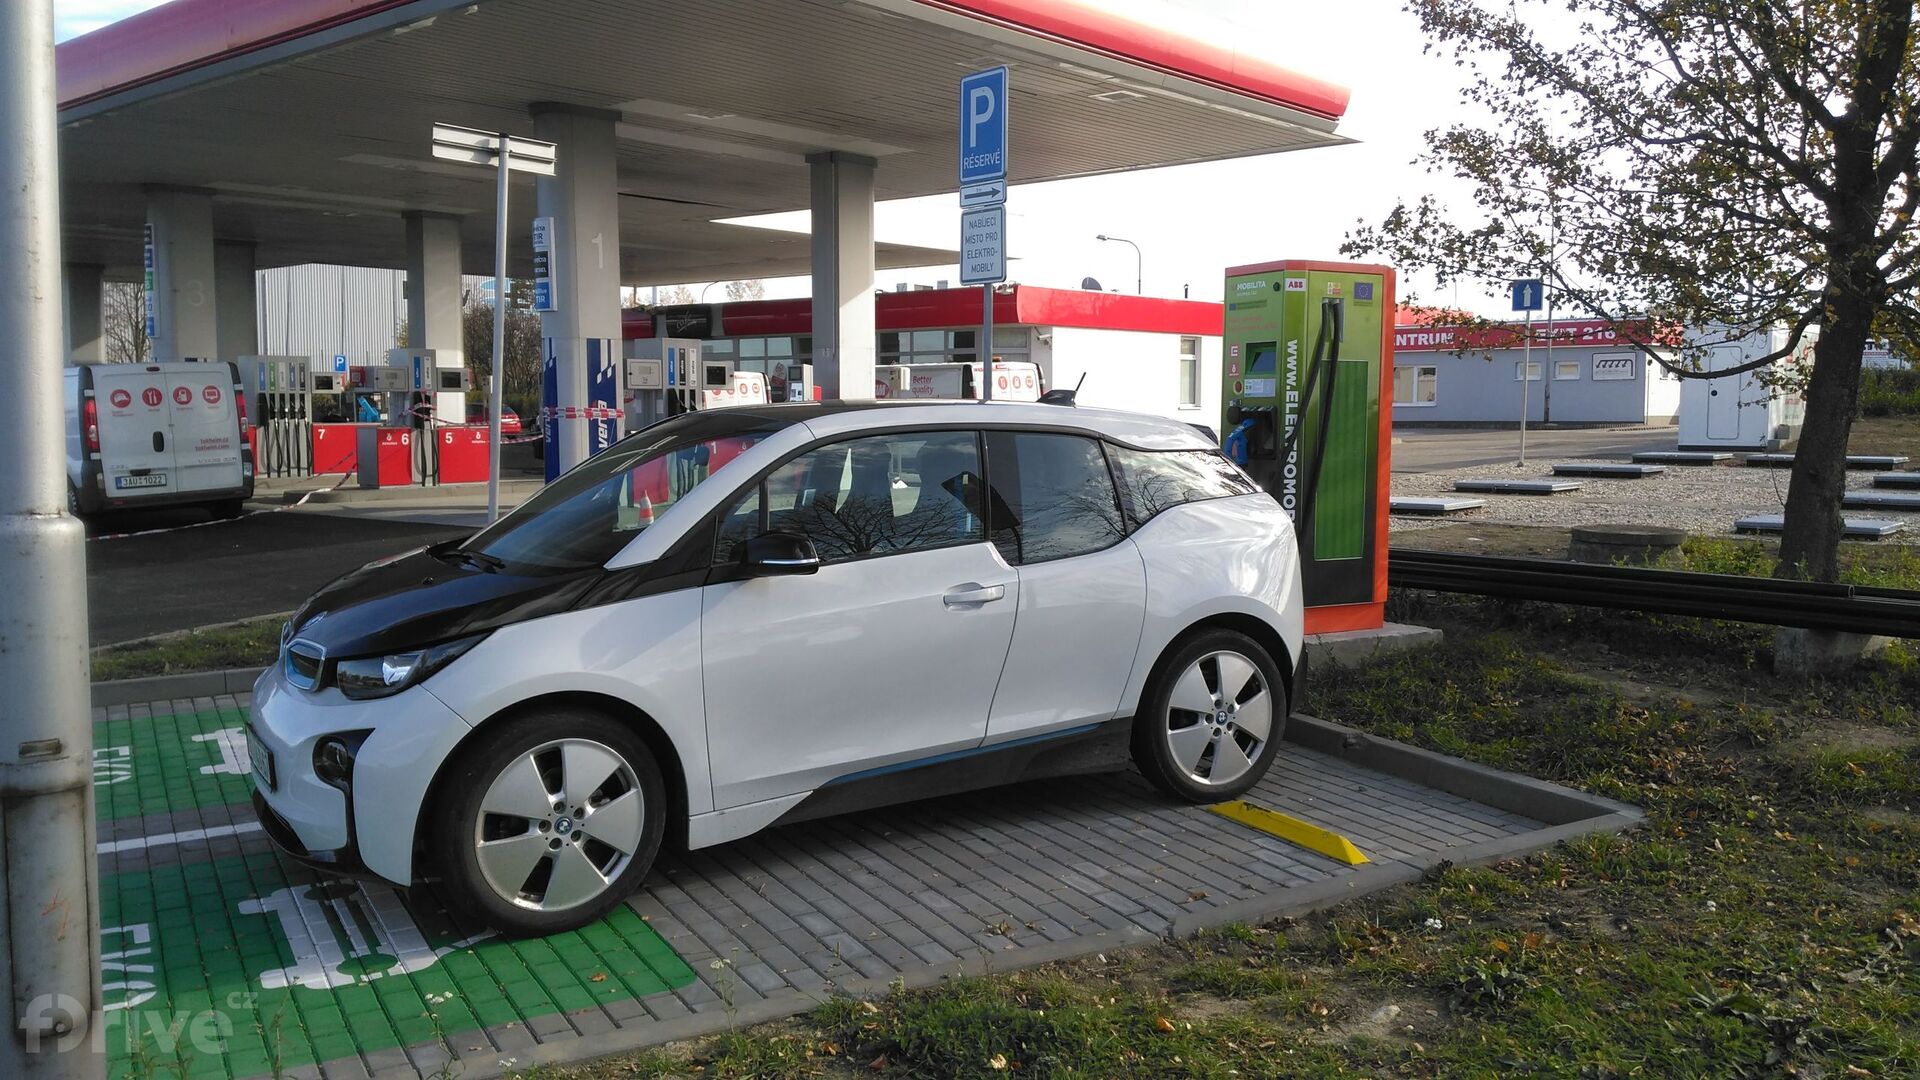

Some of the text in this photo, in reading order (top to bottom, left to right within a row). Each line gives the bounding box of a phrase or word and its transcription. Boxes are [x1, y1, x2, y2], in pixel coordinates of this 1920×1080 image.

[970, 86, 995, 148] P
[963, 149, 1001, 169] RÉSERVÉ
[985, 231, 998, 242] PRO
[966, 247, 998, 259] ELEKTRO-
[971, 262, 994, 273] MOBILY
[1287, 281, 1304, 289] ABB
[1582, 326, 1616, 340] 216
[336, 356, 344, 367] P
[912, 375, 933, 384] Better
[912, 385, 934, 398] quality
[318, 429, 326, 440] 7
[401, 433, 409, 445] 6
[445, 432, 453, 444] 5
[144, 476, 163, 485] 1022
